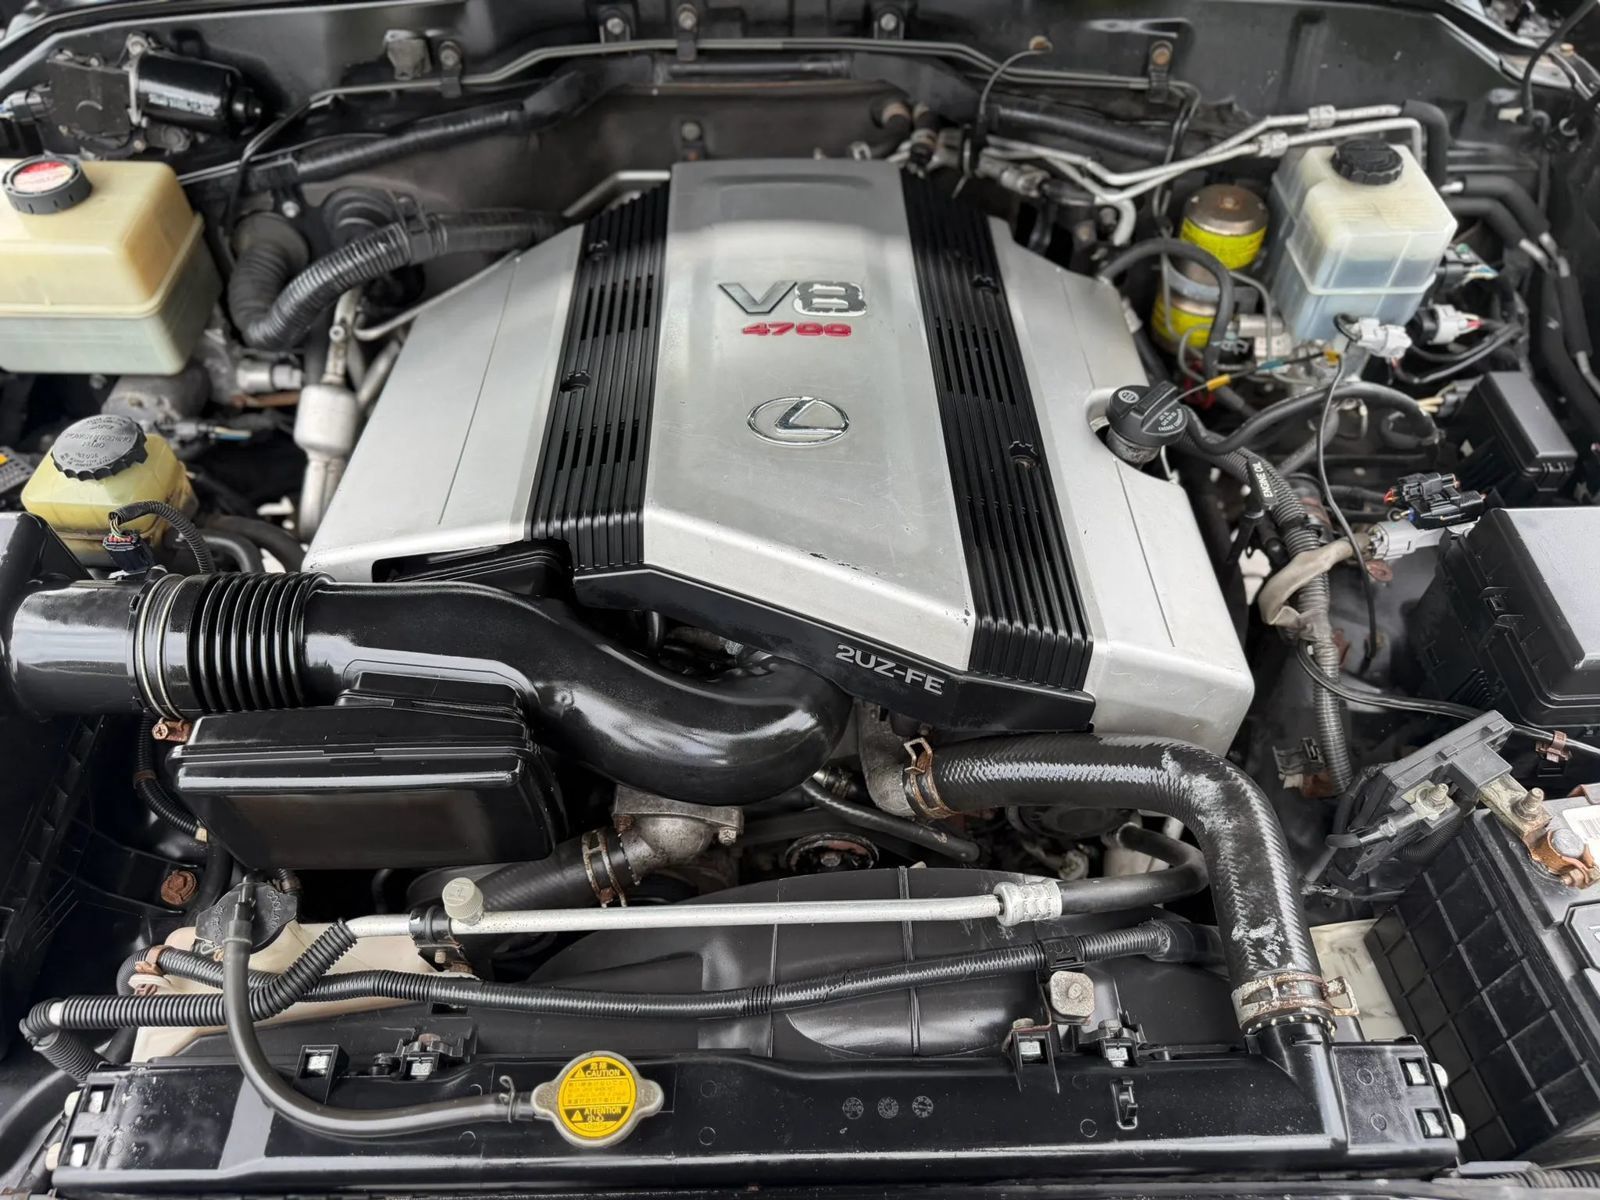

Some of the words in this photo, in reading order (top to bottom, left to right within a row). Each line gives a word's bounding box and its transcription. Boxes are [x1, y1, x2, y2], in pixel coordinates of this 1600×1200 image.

[718, 280, 867, 316] V8
[741, 322, 852, 336] 4700
[1256, 473, 1273, 497] ENGINE
[835, 644, 945, 695] 2UZ-FE
[586, 1069, 620, 1077] CAUTION
[584, 1106, 622, 1115] ATTENTION
